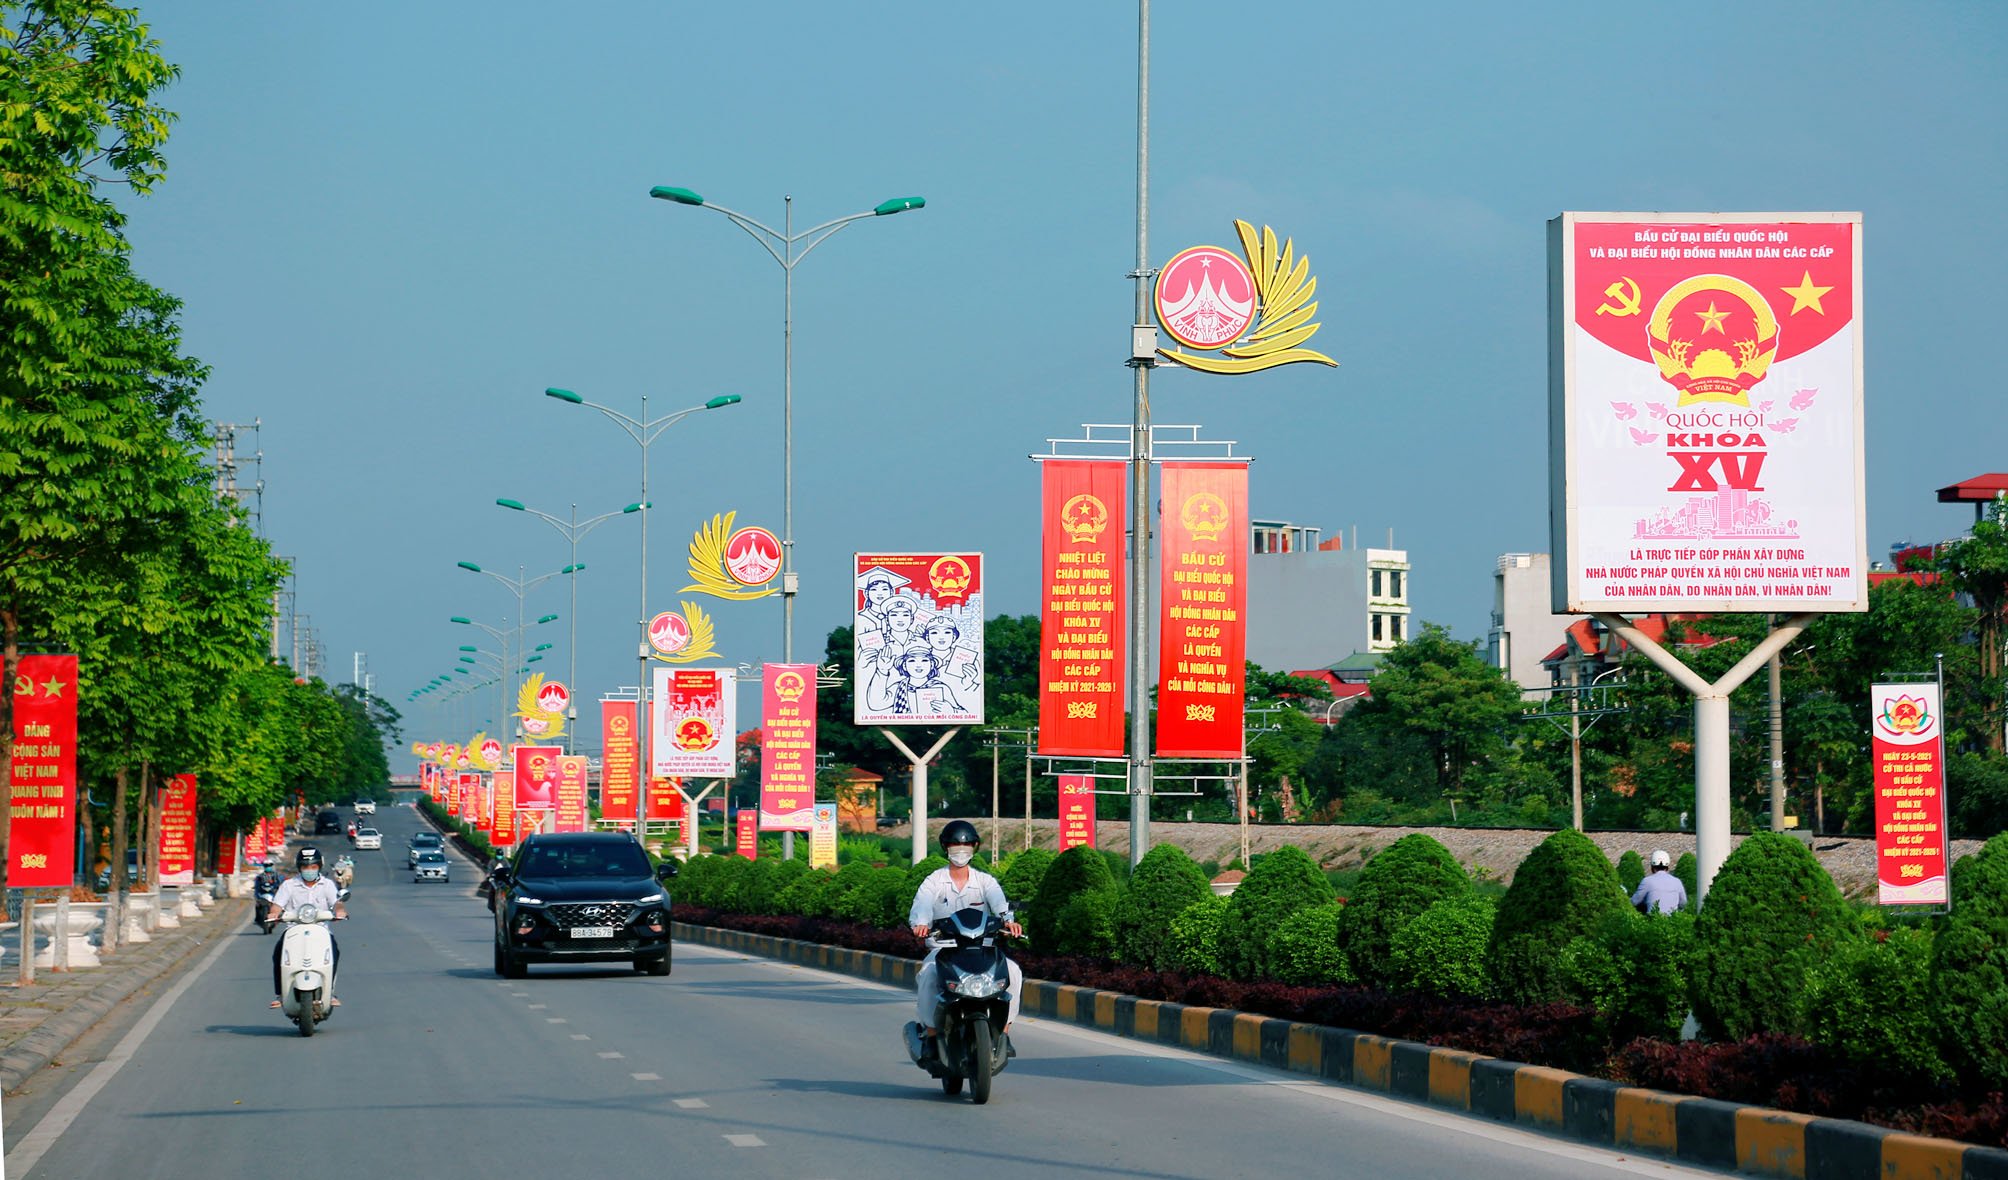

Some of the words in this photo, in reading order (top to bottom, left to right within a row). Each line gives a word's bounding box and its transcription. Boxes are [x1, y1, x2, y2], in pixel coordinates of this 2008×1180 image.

[1634, 229, 1658, 242] BẦU
[1661, 228, 1679, 242] CỬ
[1680, 232, 1701, 244] ĐẠI
[1703, 228, 1730, 242] BIỂU
[1733, 229, 1765, 243] QUỐC
[1768, 230, 1788, 244] HỘI
[1589, 246, 1605, 258] VÀ
[1607, 248, 1628, 260] ĐẠI
[1631, 245, 1658, 258] BIỂU
[1661, 246, 1681, 260] HỘI
[1683, 245, 1716, 259] ĐỒNG
[1719, 246, 1752, 258] NHÂN
[1755, 246, 1780, 258] DÂN
[1783, 246, 1807, 258] CÁC
[1810, 245, 1834, 258] CẤP
[1695, 384, 1713, 392] VIỆT
[1666, 407, 1723, 430] QUỐC
[1729, 410, 1764, 433] HỘI
[1666, 430, 1767, 447] KHÓA
[1666, 452, 1768, 491] XV
[1059, 551, 1086, 565] NHIỆT
[1087, 551, 1106, 565] LIỆT
[1181, 551, 1205, 565] BẦU
[1208, 553, 1226, 566] CỬ
[1630, 549, 1643, 560] LÀ
[1645, 549, 1671, 560] TRỰC
[1674, 549, 1696, 560] TIẾP
[1699, 549, 1720, 560] GÓP
[1723, 548, 1751, 560] PHẦN
[1754, 548, 1773, 560] XÂY
[1776, 548, 1804, 560] DỰNG
[1056, 567, 1080, 579] CHÀO
[1082, 567, 1110, 579] MỪNG
[1173, 570, 1186, 584] ĐẠI
[1186, 570, 1202, 583] BIỂU
[1203, 571, 1221, 584] QUỐC
[1222, 572, 1233, 587] HỘI
[1586, 567, 1607, 579] NHÀ
[1610, 566, 1638, 579] NƯỚC
[1641, 567, 1668, 578] PHÁP
[1671, 566, 1704, 579] QUYỀN
[1707, 567, 1721, 578] XÃ
[1724, 567, 1741, 580] HỘI
[1744, 564, 1765, 578] CHỦ
[1767, 567, 1799, 578] NGHĨA
[1802, 567, 1823, 578] VIỆT
[1826, 567, 1850, 578] NAM
[1052, 583, 1077, 595] NGÀY
[1079, 582, 1097, 595] BẦU
[1099, 582, 1112, 595] CỬ
[1181, 587, 1192, 601] VÀ
[1193, 590, 1207, 603] ĐẠI
[1208, 588, 1226, 603] BIỂU
[1605, 582, 1625, 597] CỦA
[1628, 584, 1657, 596] NHÂN
[1660, 584, 1684, 597] DÂN,
[1687, 585, 1700, 596] DO
[1703, 584, 1732, 596] NHÂN
[1735, 584, 1759, 596] DÂN,
[1762, 585, 1772, 596] VÌ
[1775, 584, 1804, 596] NHÂN
[1806, 585, 1831, 596] DÂN!
[1050, 601, 1063, 613] ĐẠI
[1064, 598, 1081, 611] BIỂU
[1082, 598, 1101, 612] QUỐC
[1102, 599, 1114, 613] HỘI
[1170, 605, 1182, 620] HỘI
[1182, 606, 1201, 619] ĐỒNG
[1202, 607, 1221, 620] NHÂN
[1222, 608, 1236, 621] DÂN
[1064, 615, 1088, 628] KHÓA
[1089, 617, 1101, 628] XV
[1057, 631, 1070, 644] VÀ
[1071, 633, 1086, 646] ĐẠI
[1088, 629, 1108, 644] BIỂU
[1186, 624, 1202, 638] CÁC
[1203, 624, 1220, 638] CẤP
[1051, 648, 1062, 662] HỘI
[1063, 647, 1081, 660] ĐỒNG
[1082, 648, 1100, 660] NHÂN
[1100, 648, 1114, 660] DÂN
[1184, 642, 1194, 656] LÀ
[1195, 643, 1222, 657] QUYỀN
[1064, 664, 1082, 676] CÁC
[1084, 663, 1101, 676] CẤP
[1178, 660, 1189, 674] VÀ
[1190, 661, 1215, 675] NGHĨA
[1216, 664, 1227, 678] VỤ
[1168, 679, 1182, 691] CỦA
[1183, 679, 1196, 692] MỖI
[1197, 679, 1216, 693] CÔNG
[1216, 680, 1231, 694] DÂN
[14, 763, 34, 780] VIỆT
[36, 765, 58, 778] NAM
